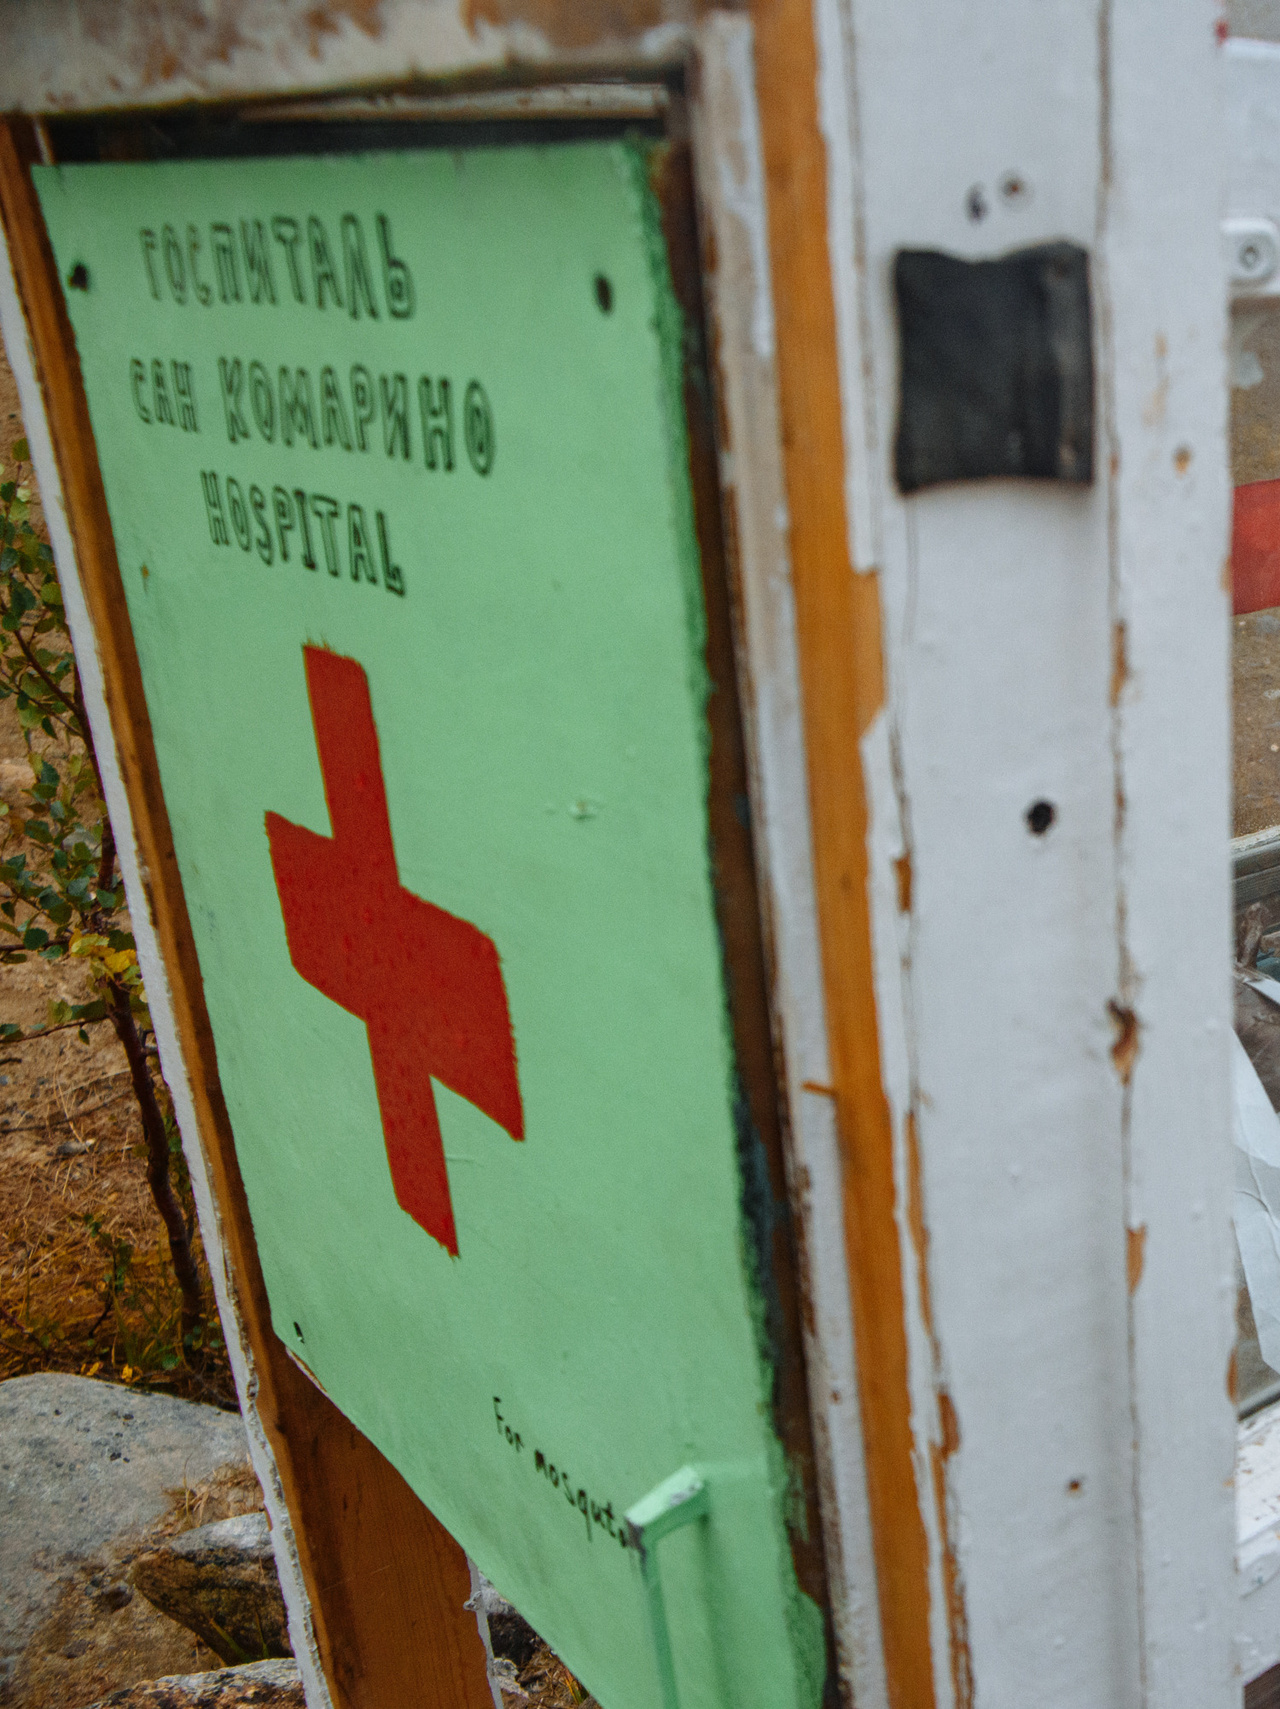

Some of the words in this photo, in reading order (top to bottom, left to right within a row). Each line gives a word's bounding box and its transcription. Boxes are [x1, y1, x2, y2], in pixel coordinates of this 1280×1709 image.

[139, 212, 417, 321] ГОСПИТАЛЬ
[129, 357, 201, 433] САН
[218, 355, 496, 478] КОМАРИНО
[201, 470, 407, 599] HOSPITAL
